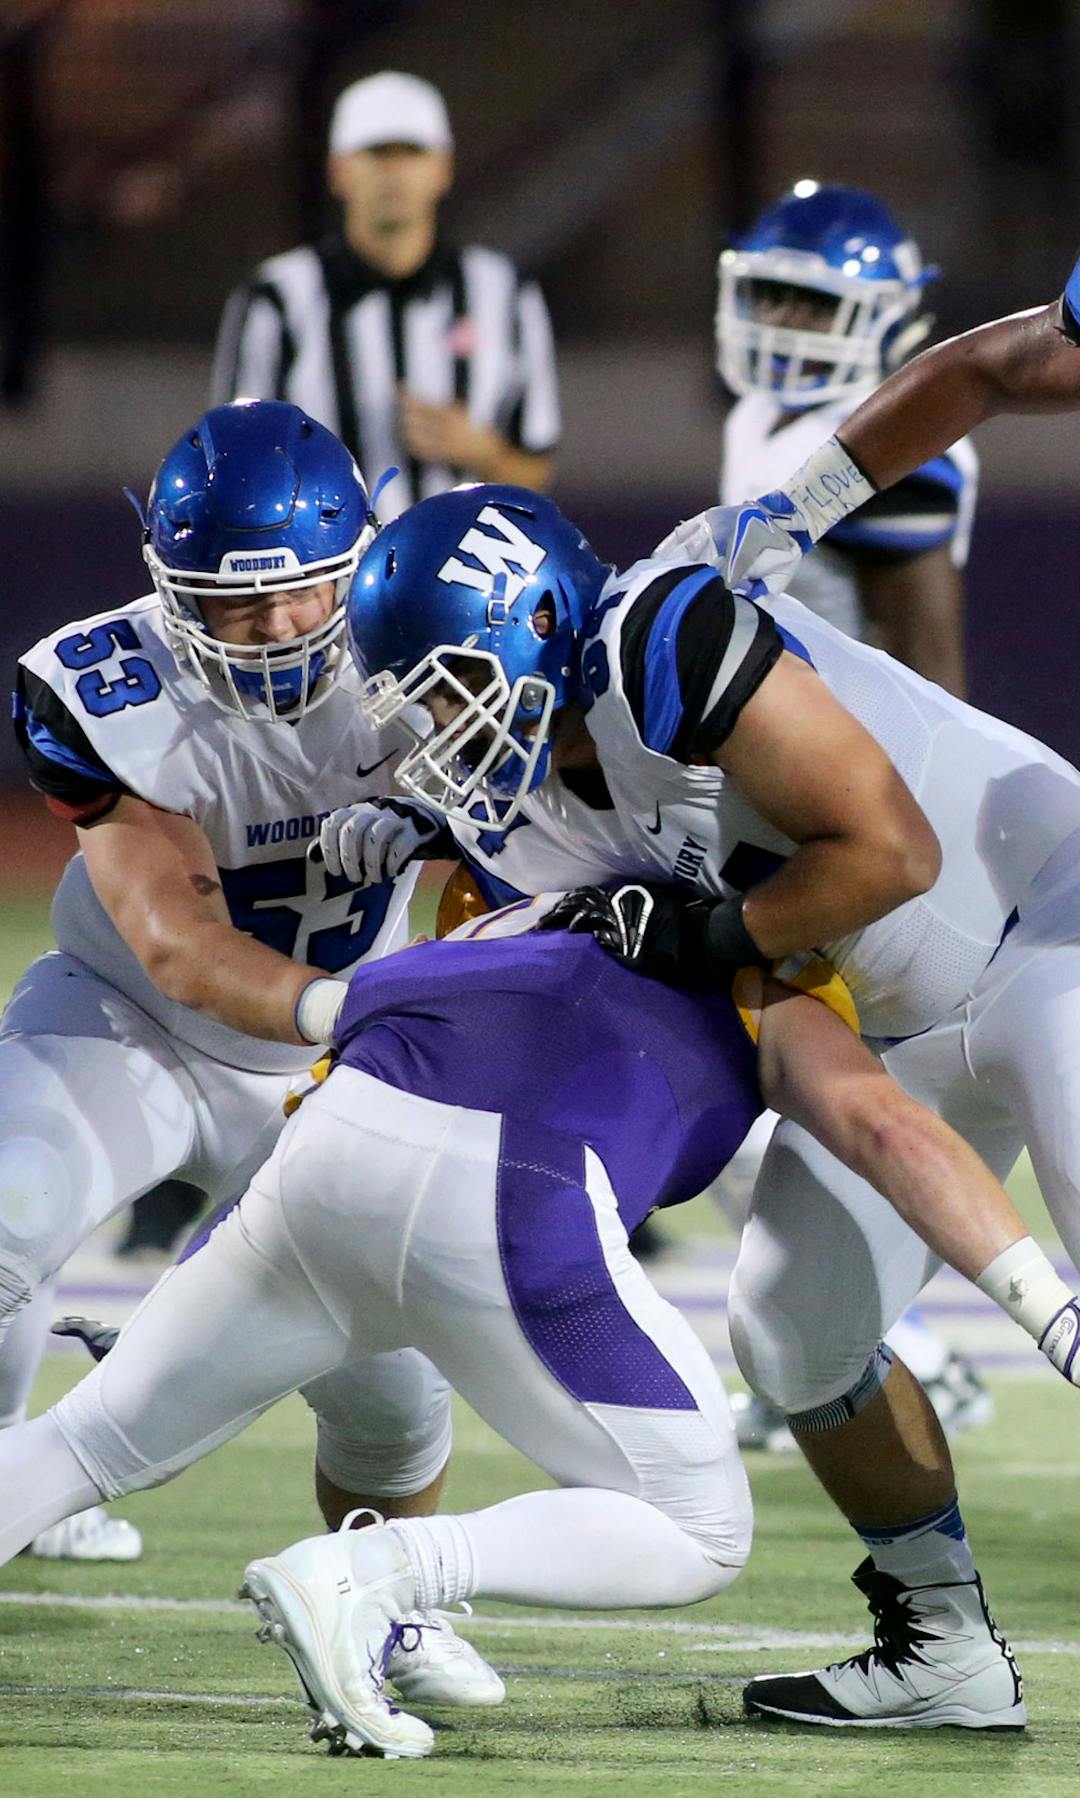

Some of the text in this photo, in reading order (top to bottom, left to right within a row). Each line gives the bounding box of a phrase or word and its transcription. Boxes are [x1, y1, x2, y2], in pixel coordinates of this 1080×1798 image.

[230, 555, 285, 573] WOODBURY
[436, 505, 548, 598] W
[54, 618, 162, 719] 53
[672, 835, 708, 886] URY
